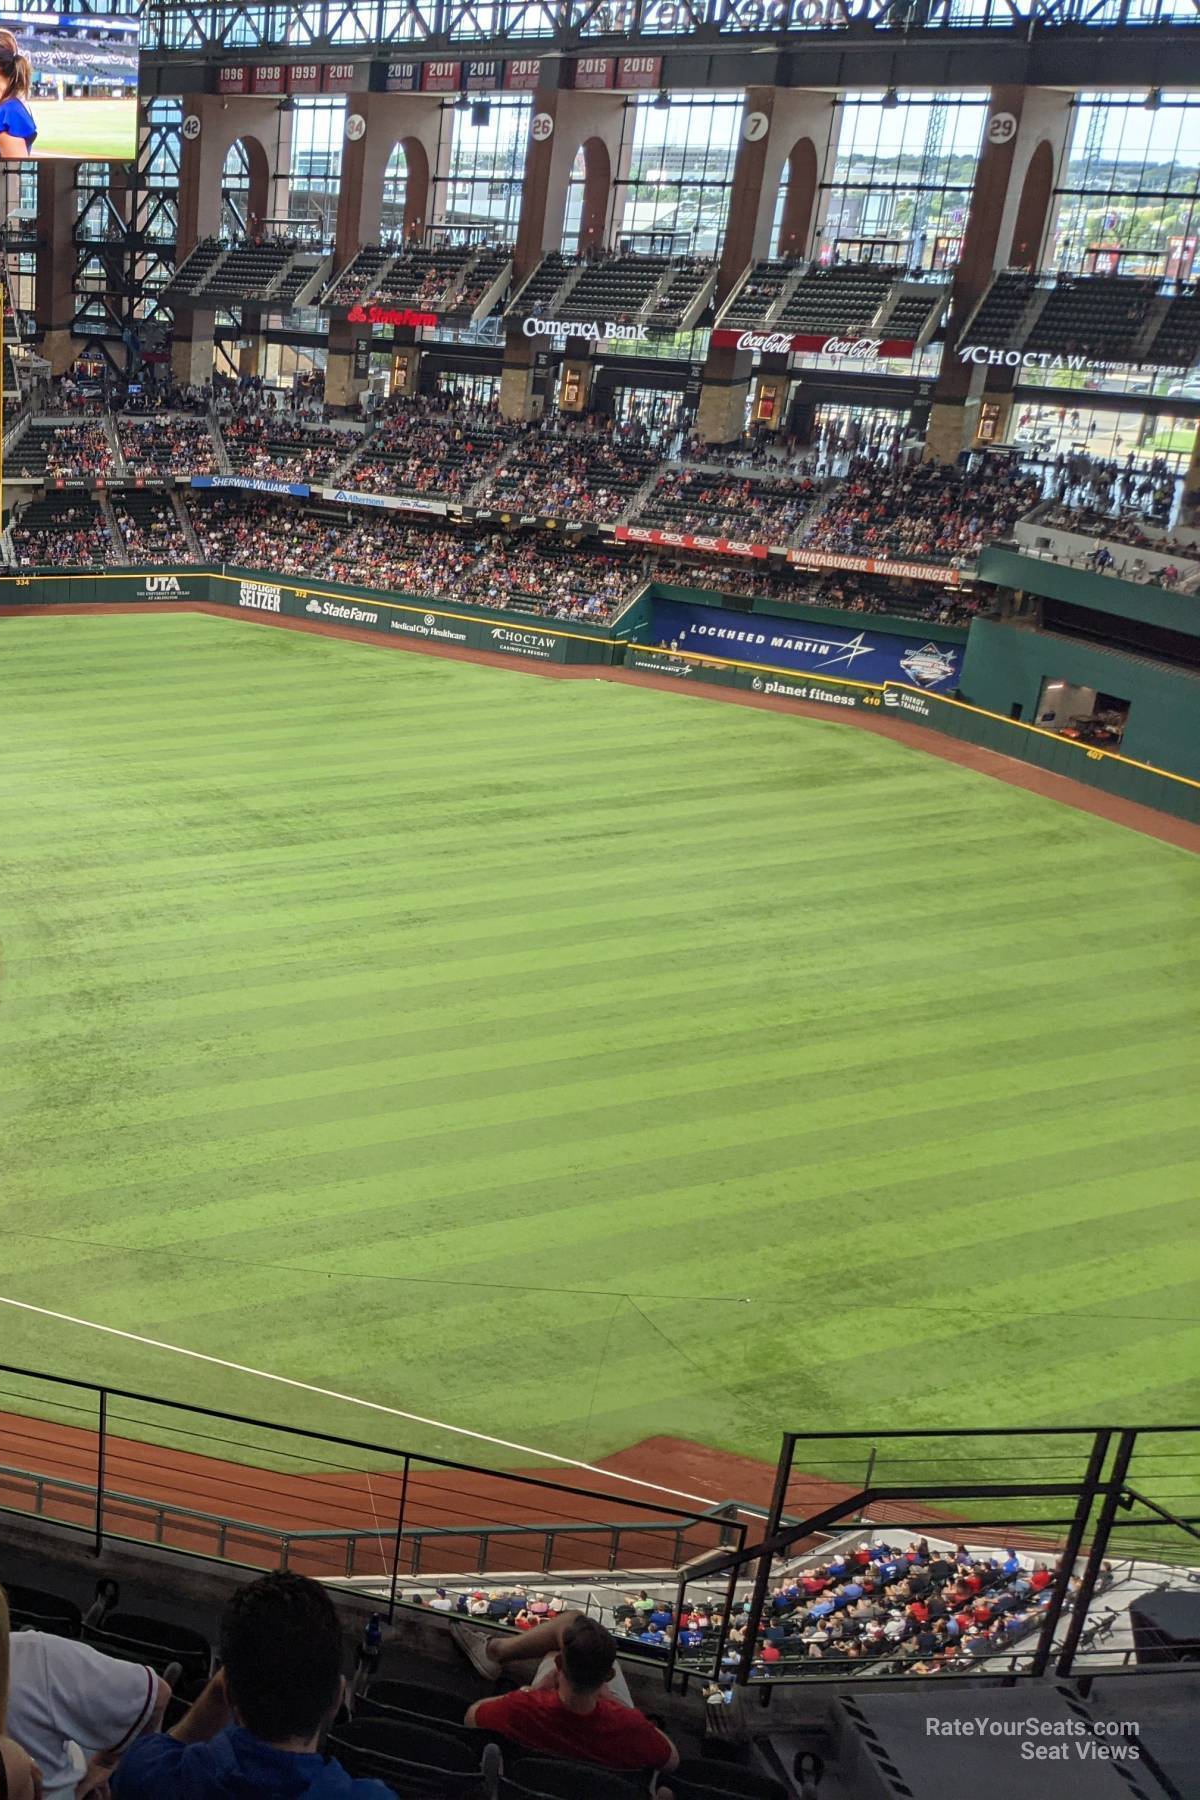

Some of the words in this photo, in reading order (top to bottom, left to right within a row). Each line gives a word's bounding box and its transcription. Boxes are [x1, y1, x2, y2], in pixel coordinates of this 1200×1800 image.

[330, 65, 353, 78] 2010
[388, 64, 413, 78] 2010
[429, 62, 454, 76] 2011
[470, 62, 494, 76] 2011
[512, 61, 540, 74] 2012
[578, 59, 606, 72] 2015
[624, 58, 654, 72] 2016
[256, 66, 280, 80] 1998
[292, 66, 316, 79] 1999
[183, 120, 198, 134] 42
[348, 121, 364, 134] 34
[533, 120, 550, 134] 26
[752, 118, 761, 134] 7
[990, 120, 1013, 136] 29
[604, 322, 649, 340] Bank
[971, 347, 1086, 370] CHOCTAW
[1086, 360, 1129, 370] CASINOS
[210, 476, 290, 494] SHERWIN-WILLIAMS
[627, 528, 650, 538] DEX
[660, 533, 684, 542] DEX
[692, 537, 718, 546] DEX
[726, 542, 752, 551] DEX
[791, 550, 868, 571] WHATABURGER
[873, 561, 953, 582] WHATABURGER
[146, 577, 180, 592] UTA
[240, 582, 256, 592] BUD
[257, 584, 281, 595] LIGHT
[240, 589, 280, 612] SELTZER
[391, 620, 416, 632] Medical
[416, 624, 430, 636] City
[430, 627, 466, 641] Healthcare
[497, 628, 556, 648] CHOCTAW
[690, 624, 766, 644] LOCKHEED
[771, 636, 830, 655] MARTIN
[764, 681, 807, 698] planet
[809, 687, 856, 706] fitness
[902, 694, 925, 707] ENERGY
[862, 696, 881, 706] 410
[901, 700, 930, 716] TRANSFER
[1086, 750, 1103, 760] 407
